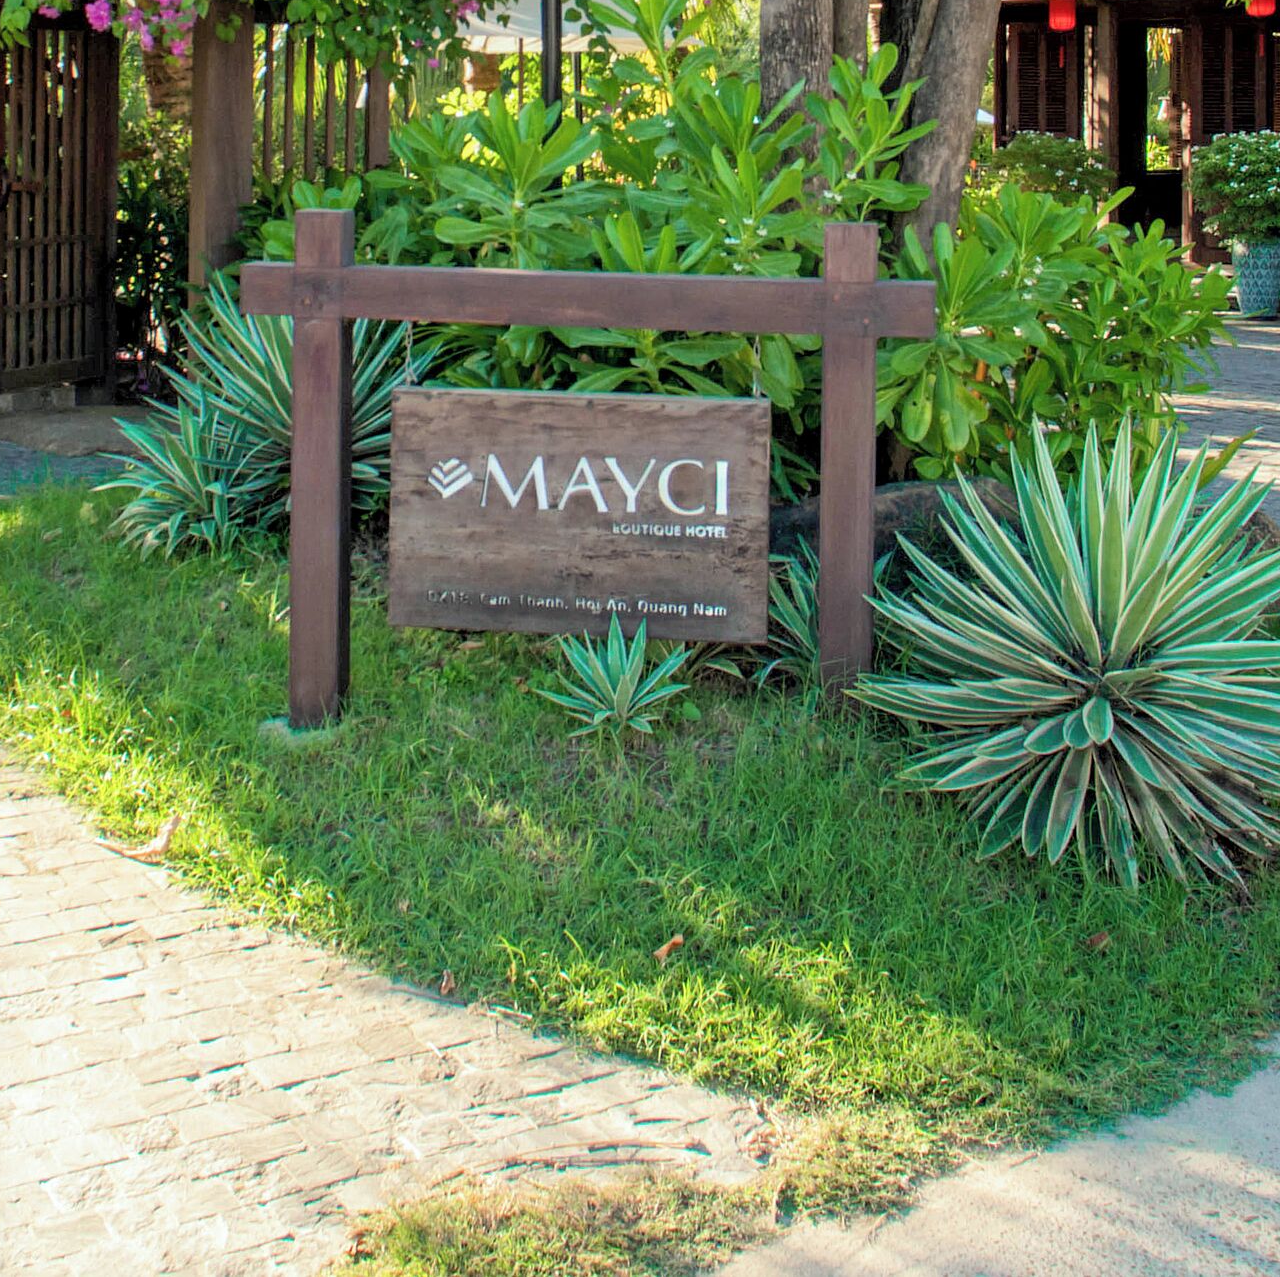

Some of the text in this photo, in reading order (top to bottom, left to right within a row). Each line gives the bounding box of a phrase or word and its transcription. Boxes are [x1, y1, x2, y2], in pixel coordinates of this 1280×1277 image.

[480, 453, 729, 516] MAYCI
[612, 522, 729, 539] BOUTIQUE HOTEL
[637, 599, 687, 617] Quang
[693, 602, 728, 617] Nam
